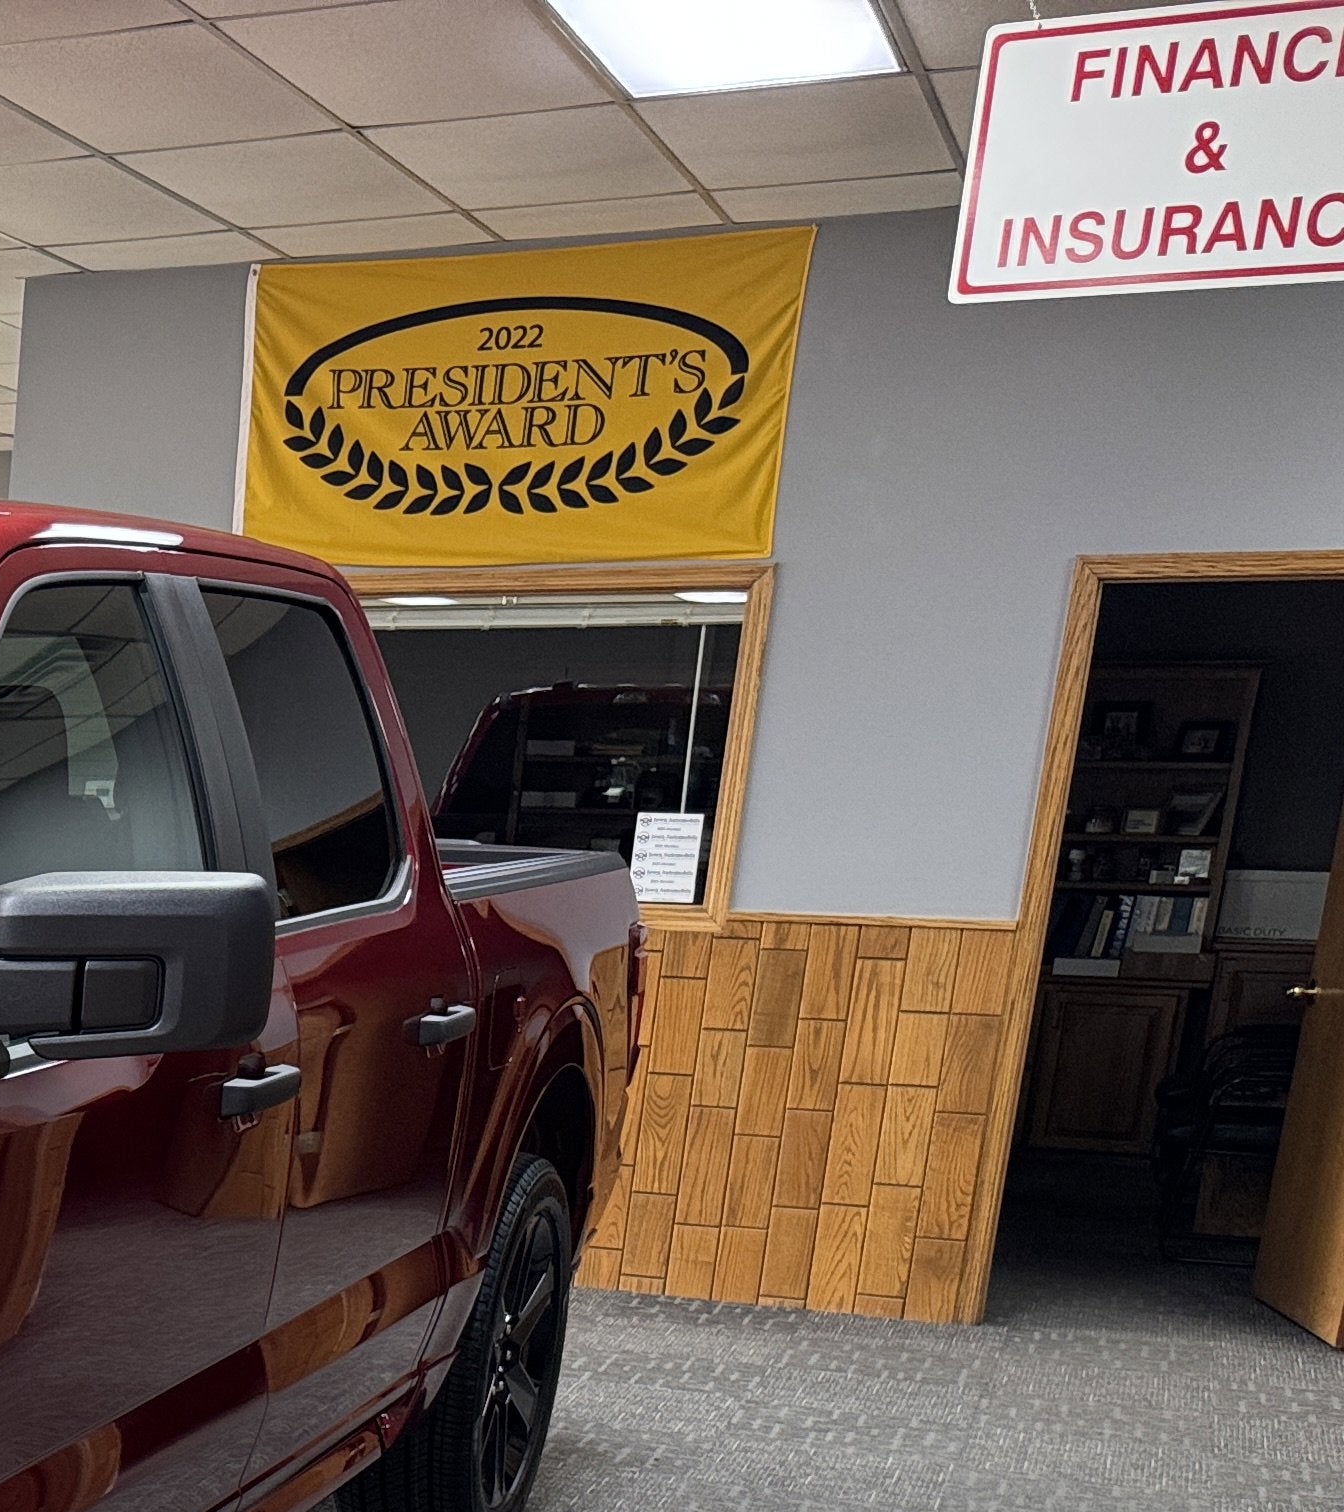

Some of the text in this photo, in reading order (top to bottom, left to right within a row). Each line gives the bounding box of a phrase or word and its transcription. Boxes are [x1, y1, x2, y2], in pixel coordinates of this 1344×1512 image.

[1069, 25, 1344, 102] FINANC
[1184, 120, 1228, 174] &
[996, 191, 1344, 268] INSURANC
[476, 324, 545, 351] 2022
[326, 349, 707, 410] PRESIDENT'S
[399, 404, 606, 452] AWARD
